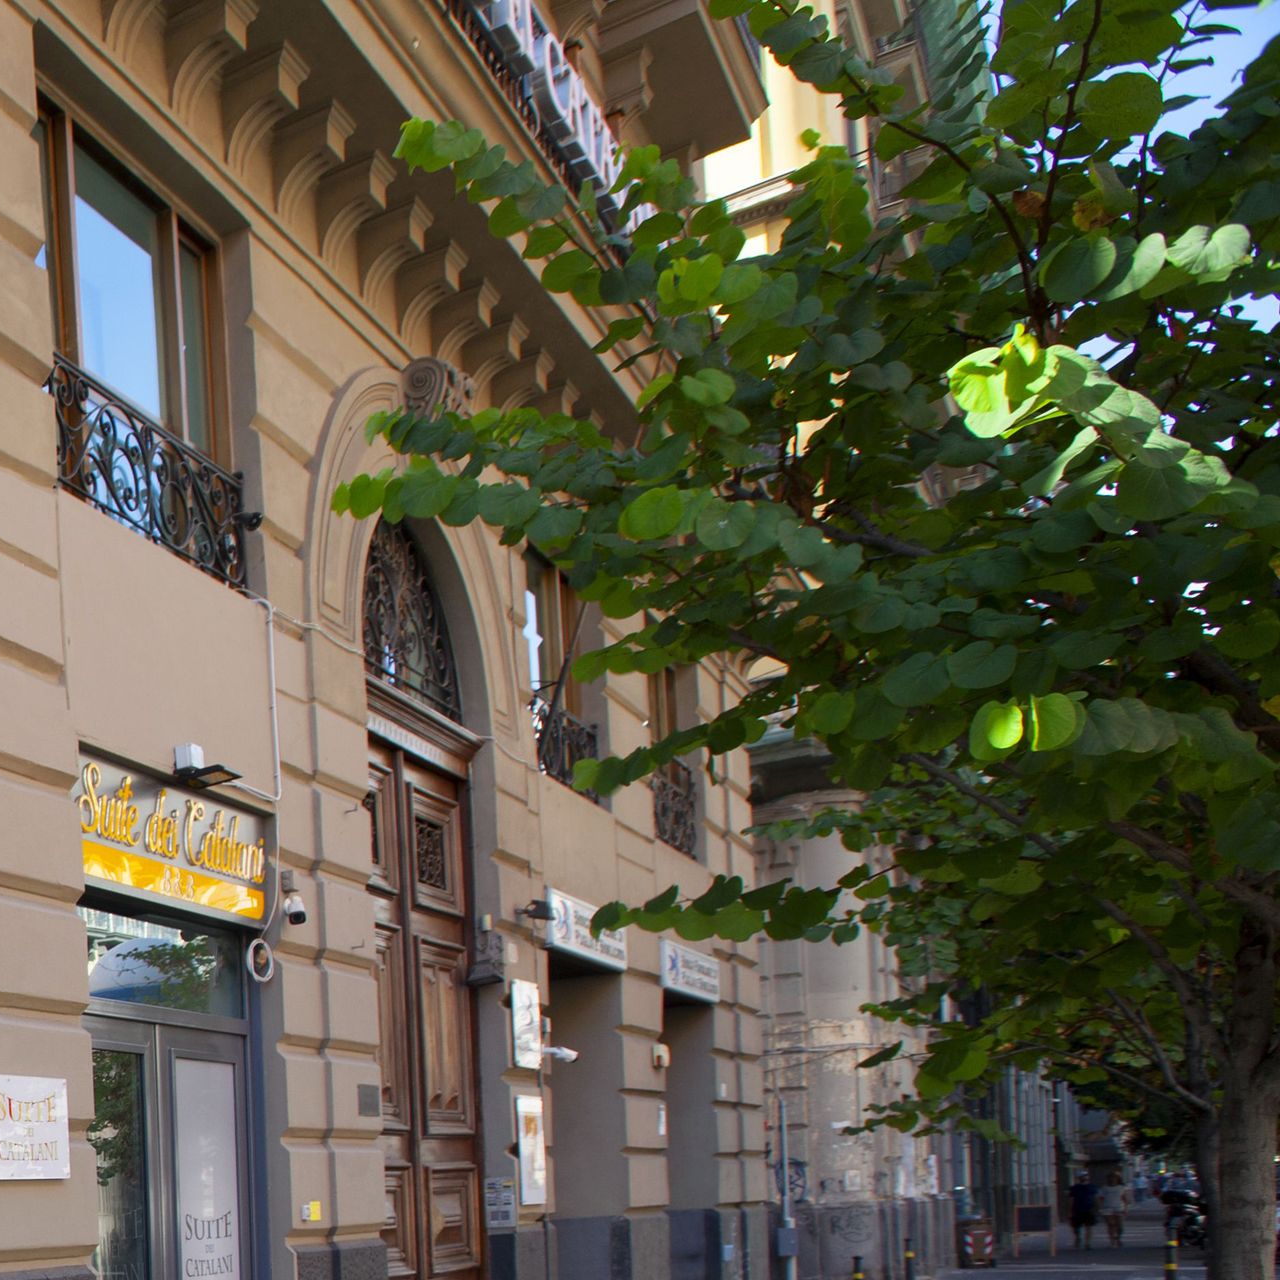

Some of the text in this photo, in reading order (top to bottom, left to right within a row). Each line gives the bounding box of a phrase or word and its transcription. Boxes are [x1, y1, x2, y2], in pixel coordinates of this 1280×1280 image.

[78, 762, 266, 884] Suite dei Catalani
[185, 1210, 232, 1242] SUITE
[185, 1254, 233, 1278] CATALANI
